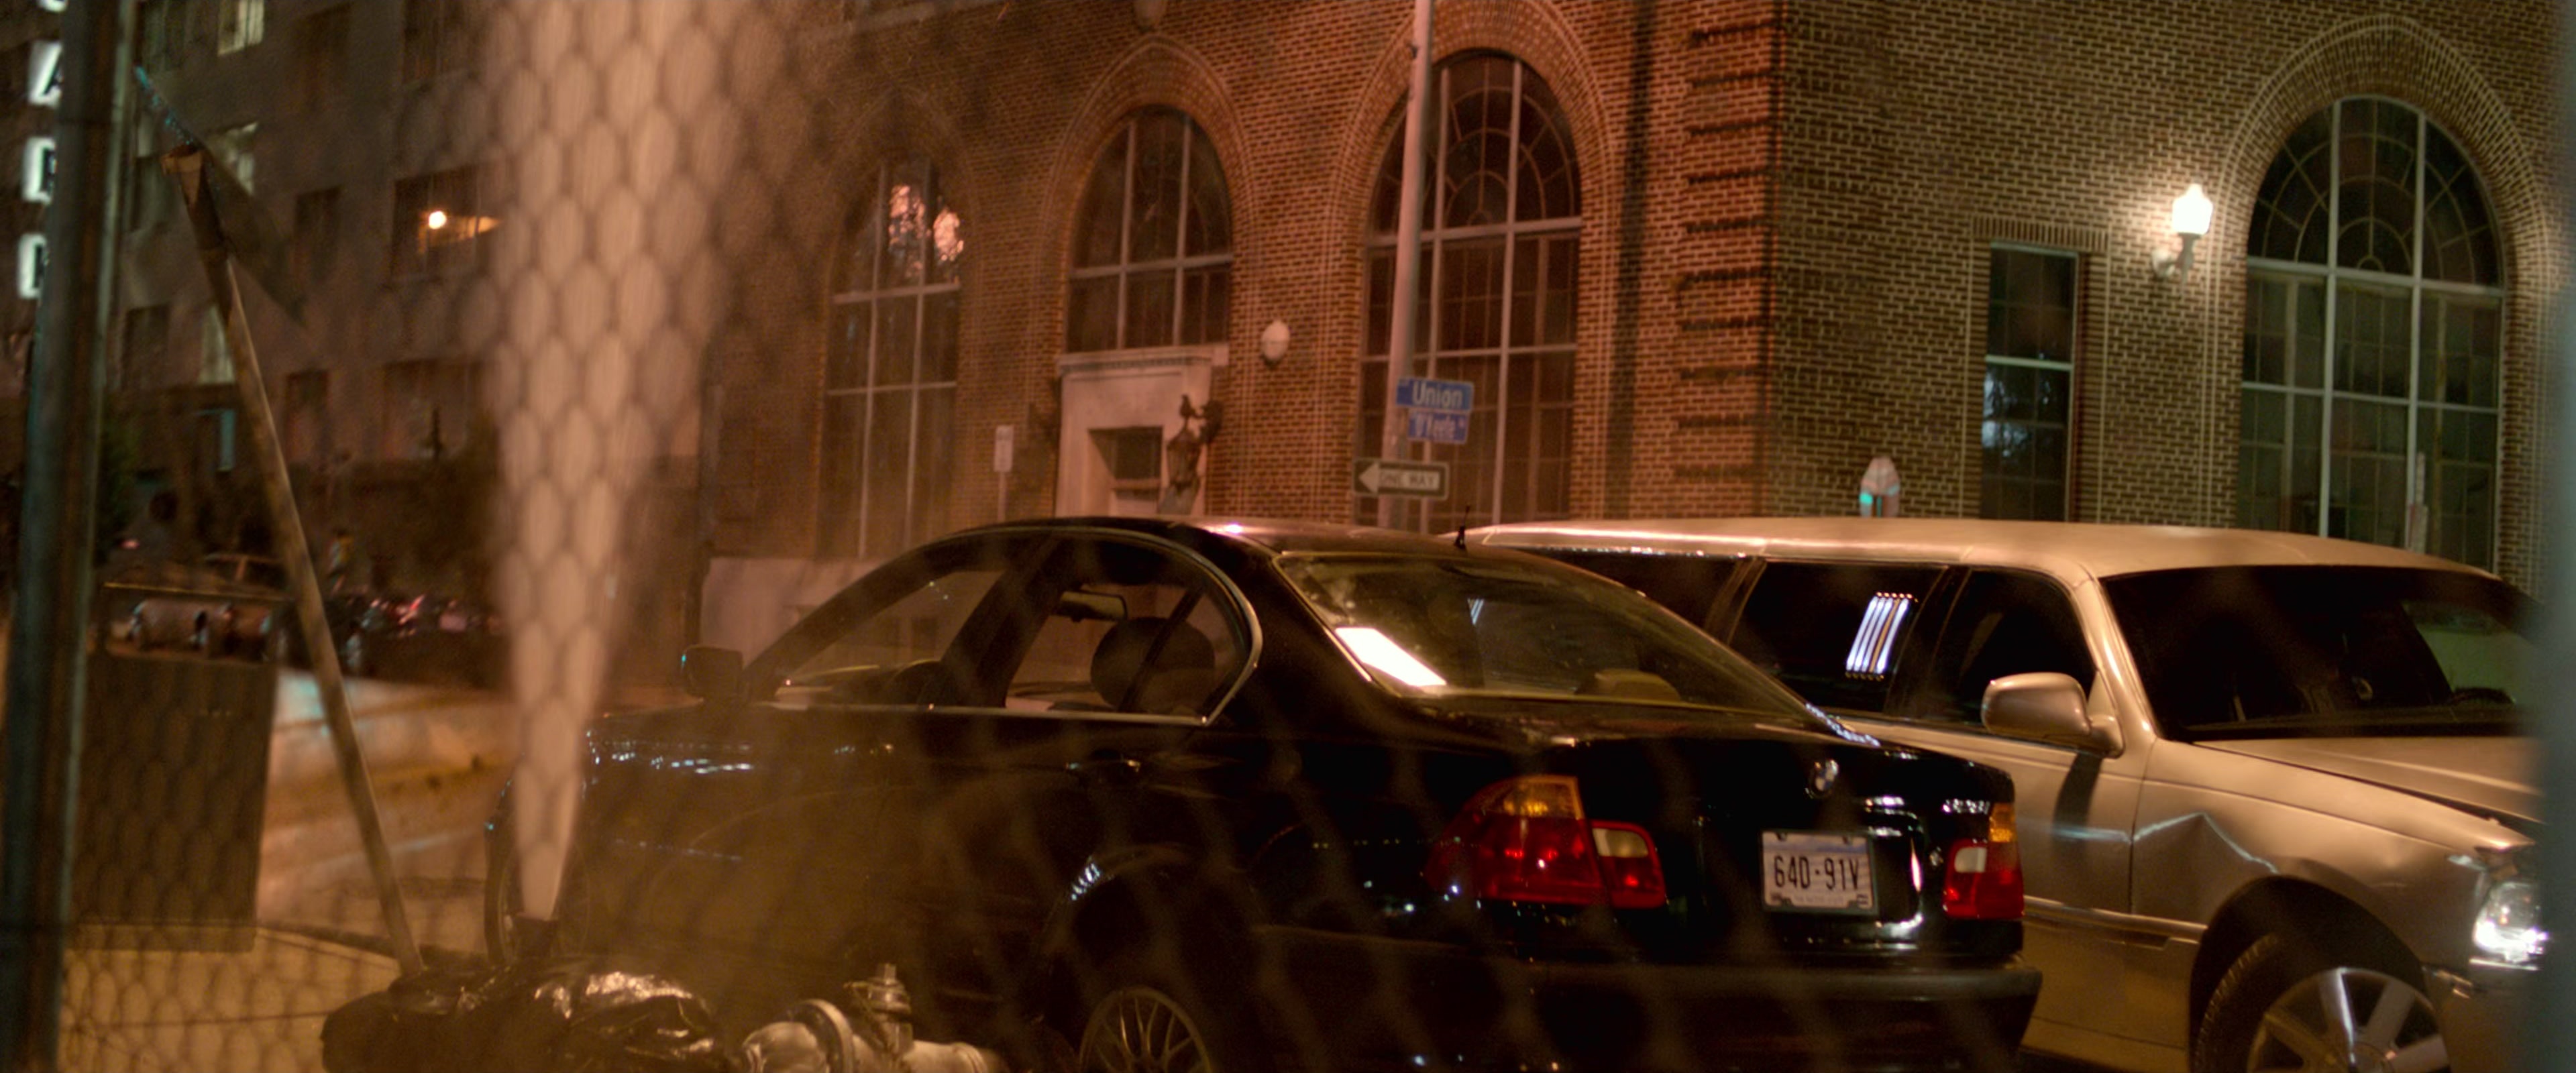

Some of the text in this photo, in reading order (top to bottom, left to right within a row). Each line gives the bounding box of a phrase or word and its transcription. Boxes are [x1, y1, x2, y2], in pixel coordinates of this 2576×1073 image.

[1411, 380, 1463, 409] Union
[1379, 471, 1436, 488] ONE WAY
